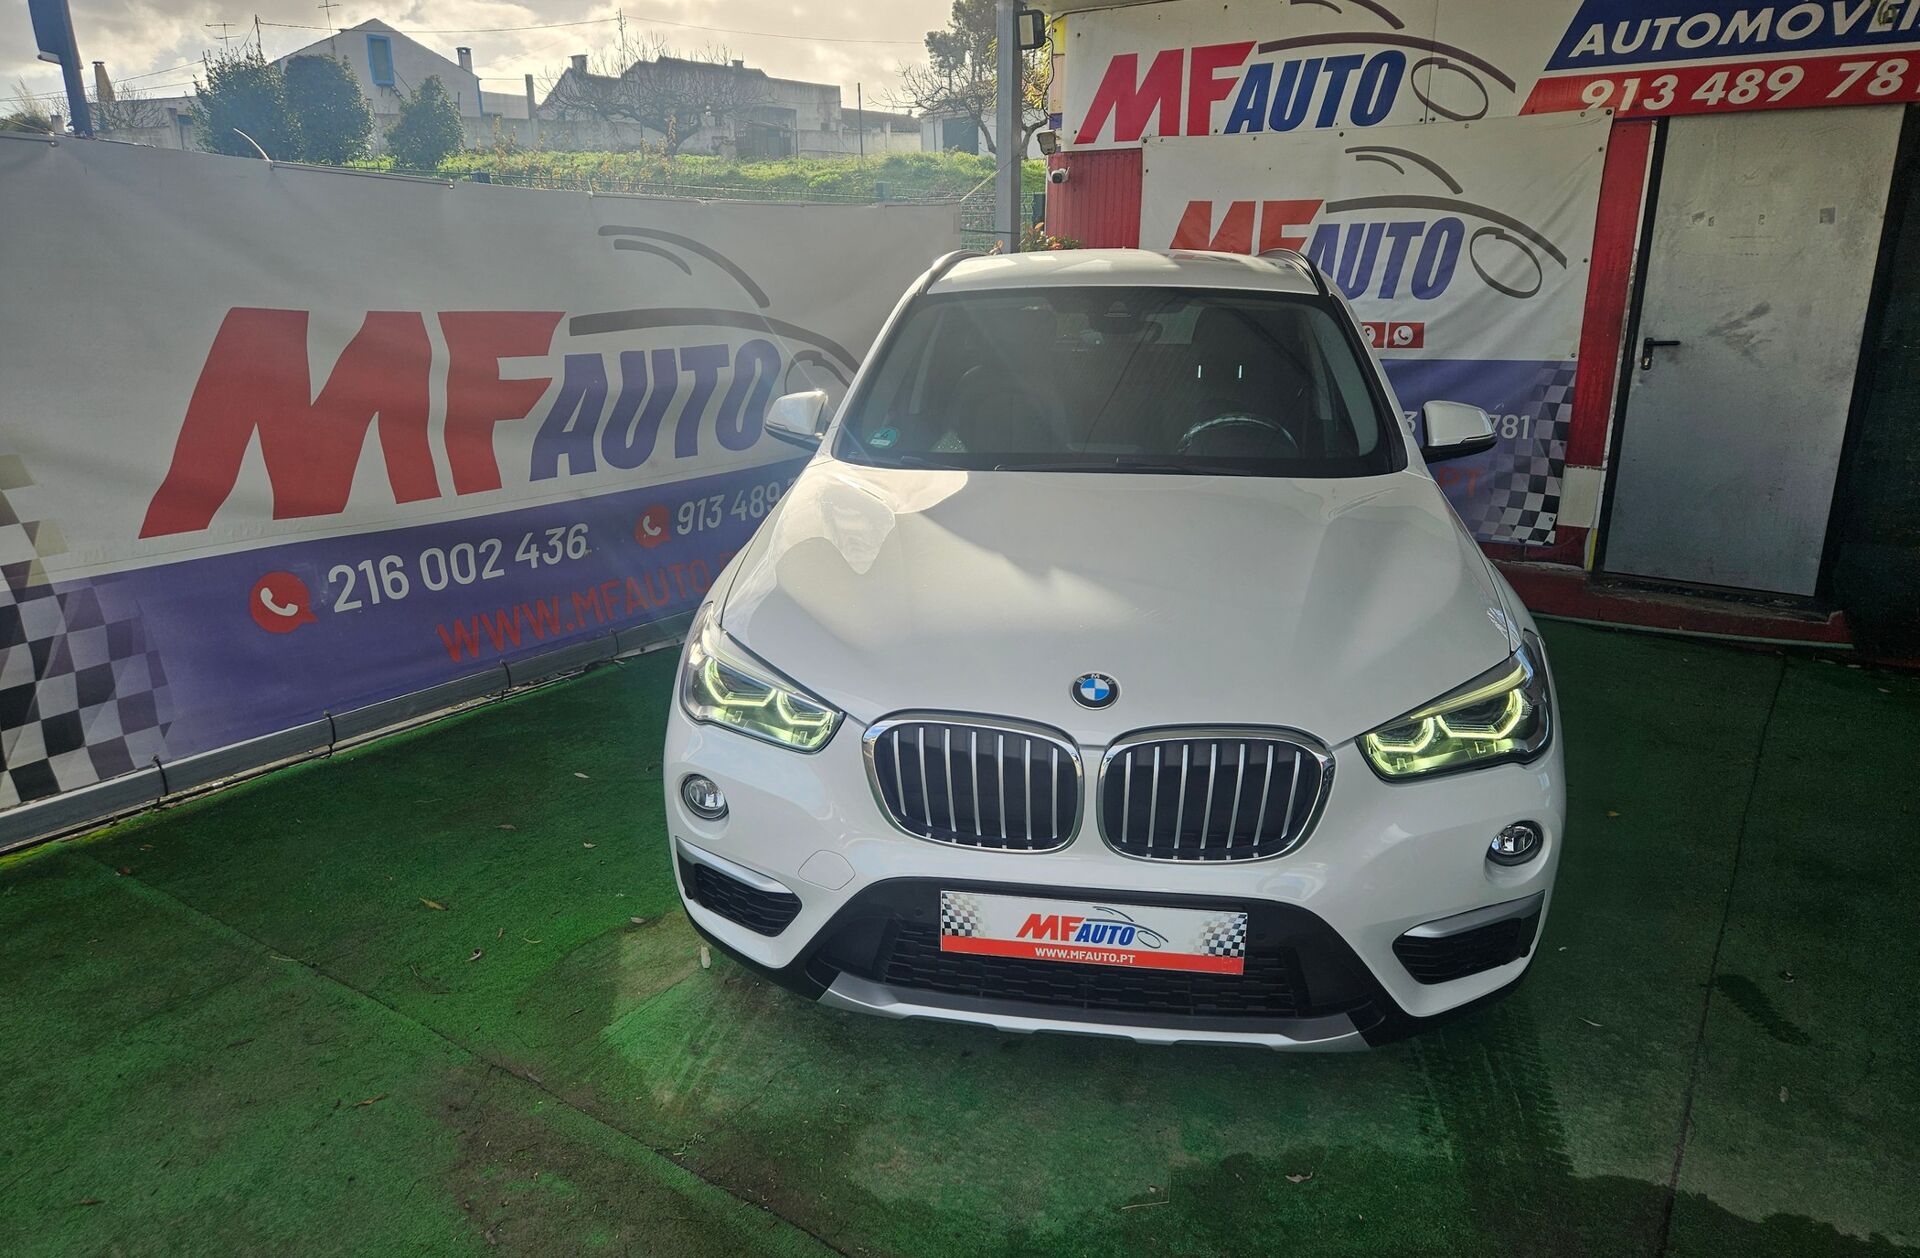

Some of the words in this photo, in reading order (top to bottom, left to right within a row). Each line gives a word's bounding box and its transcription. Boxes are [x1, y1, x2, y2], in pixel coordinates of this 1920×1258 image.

[1568, 0, 1920, 58] AUTOMOVEI
[1581, 75, 1679, 111] 913
[1691, 65, 1805, 106] 489
[1826, 58, 1920, 99] 78
[677, 495, 725, 535] 913
[731, 481, 780, 522] 489
[328, 555, 410, 613] 216
[419, 538, 505, 592] 002
[515, 523, 588, 569] 436
[1035, 947, 1136, 964] WWW.MFAUTO.PT
